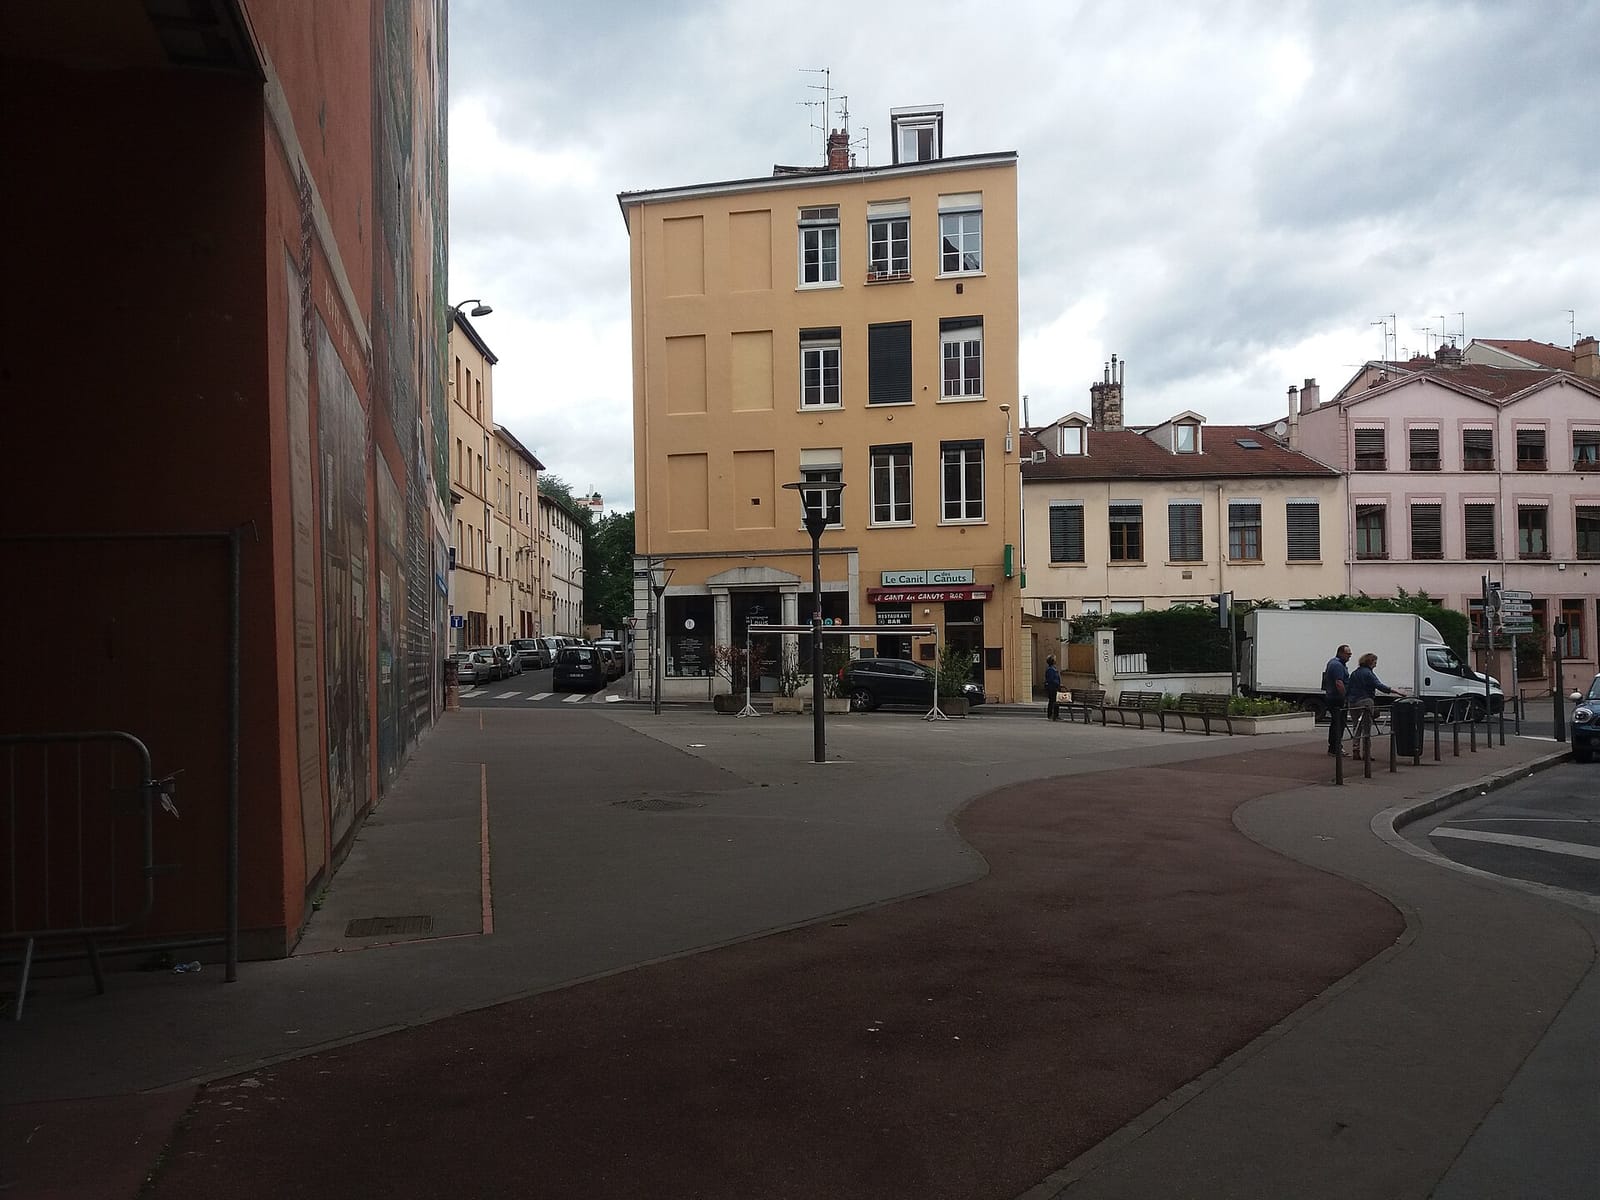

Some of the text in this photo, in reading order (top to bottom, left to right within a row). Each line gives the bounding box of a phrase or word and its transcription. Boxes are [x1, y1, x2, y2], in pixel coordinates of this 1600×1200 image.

[885, 574, 967, 584] Le Canit Canuts
[917, 592, 945, 600] CANUTS
